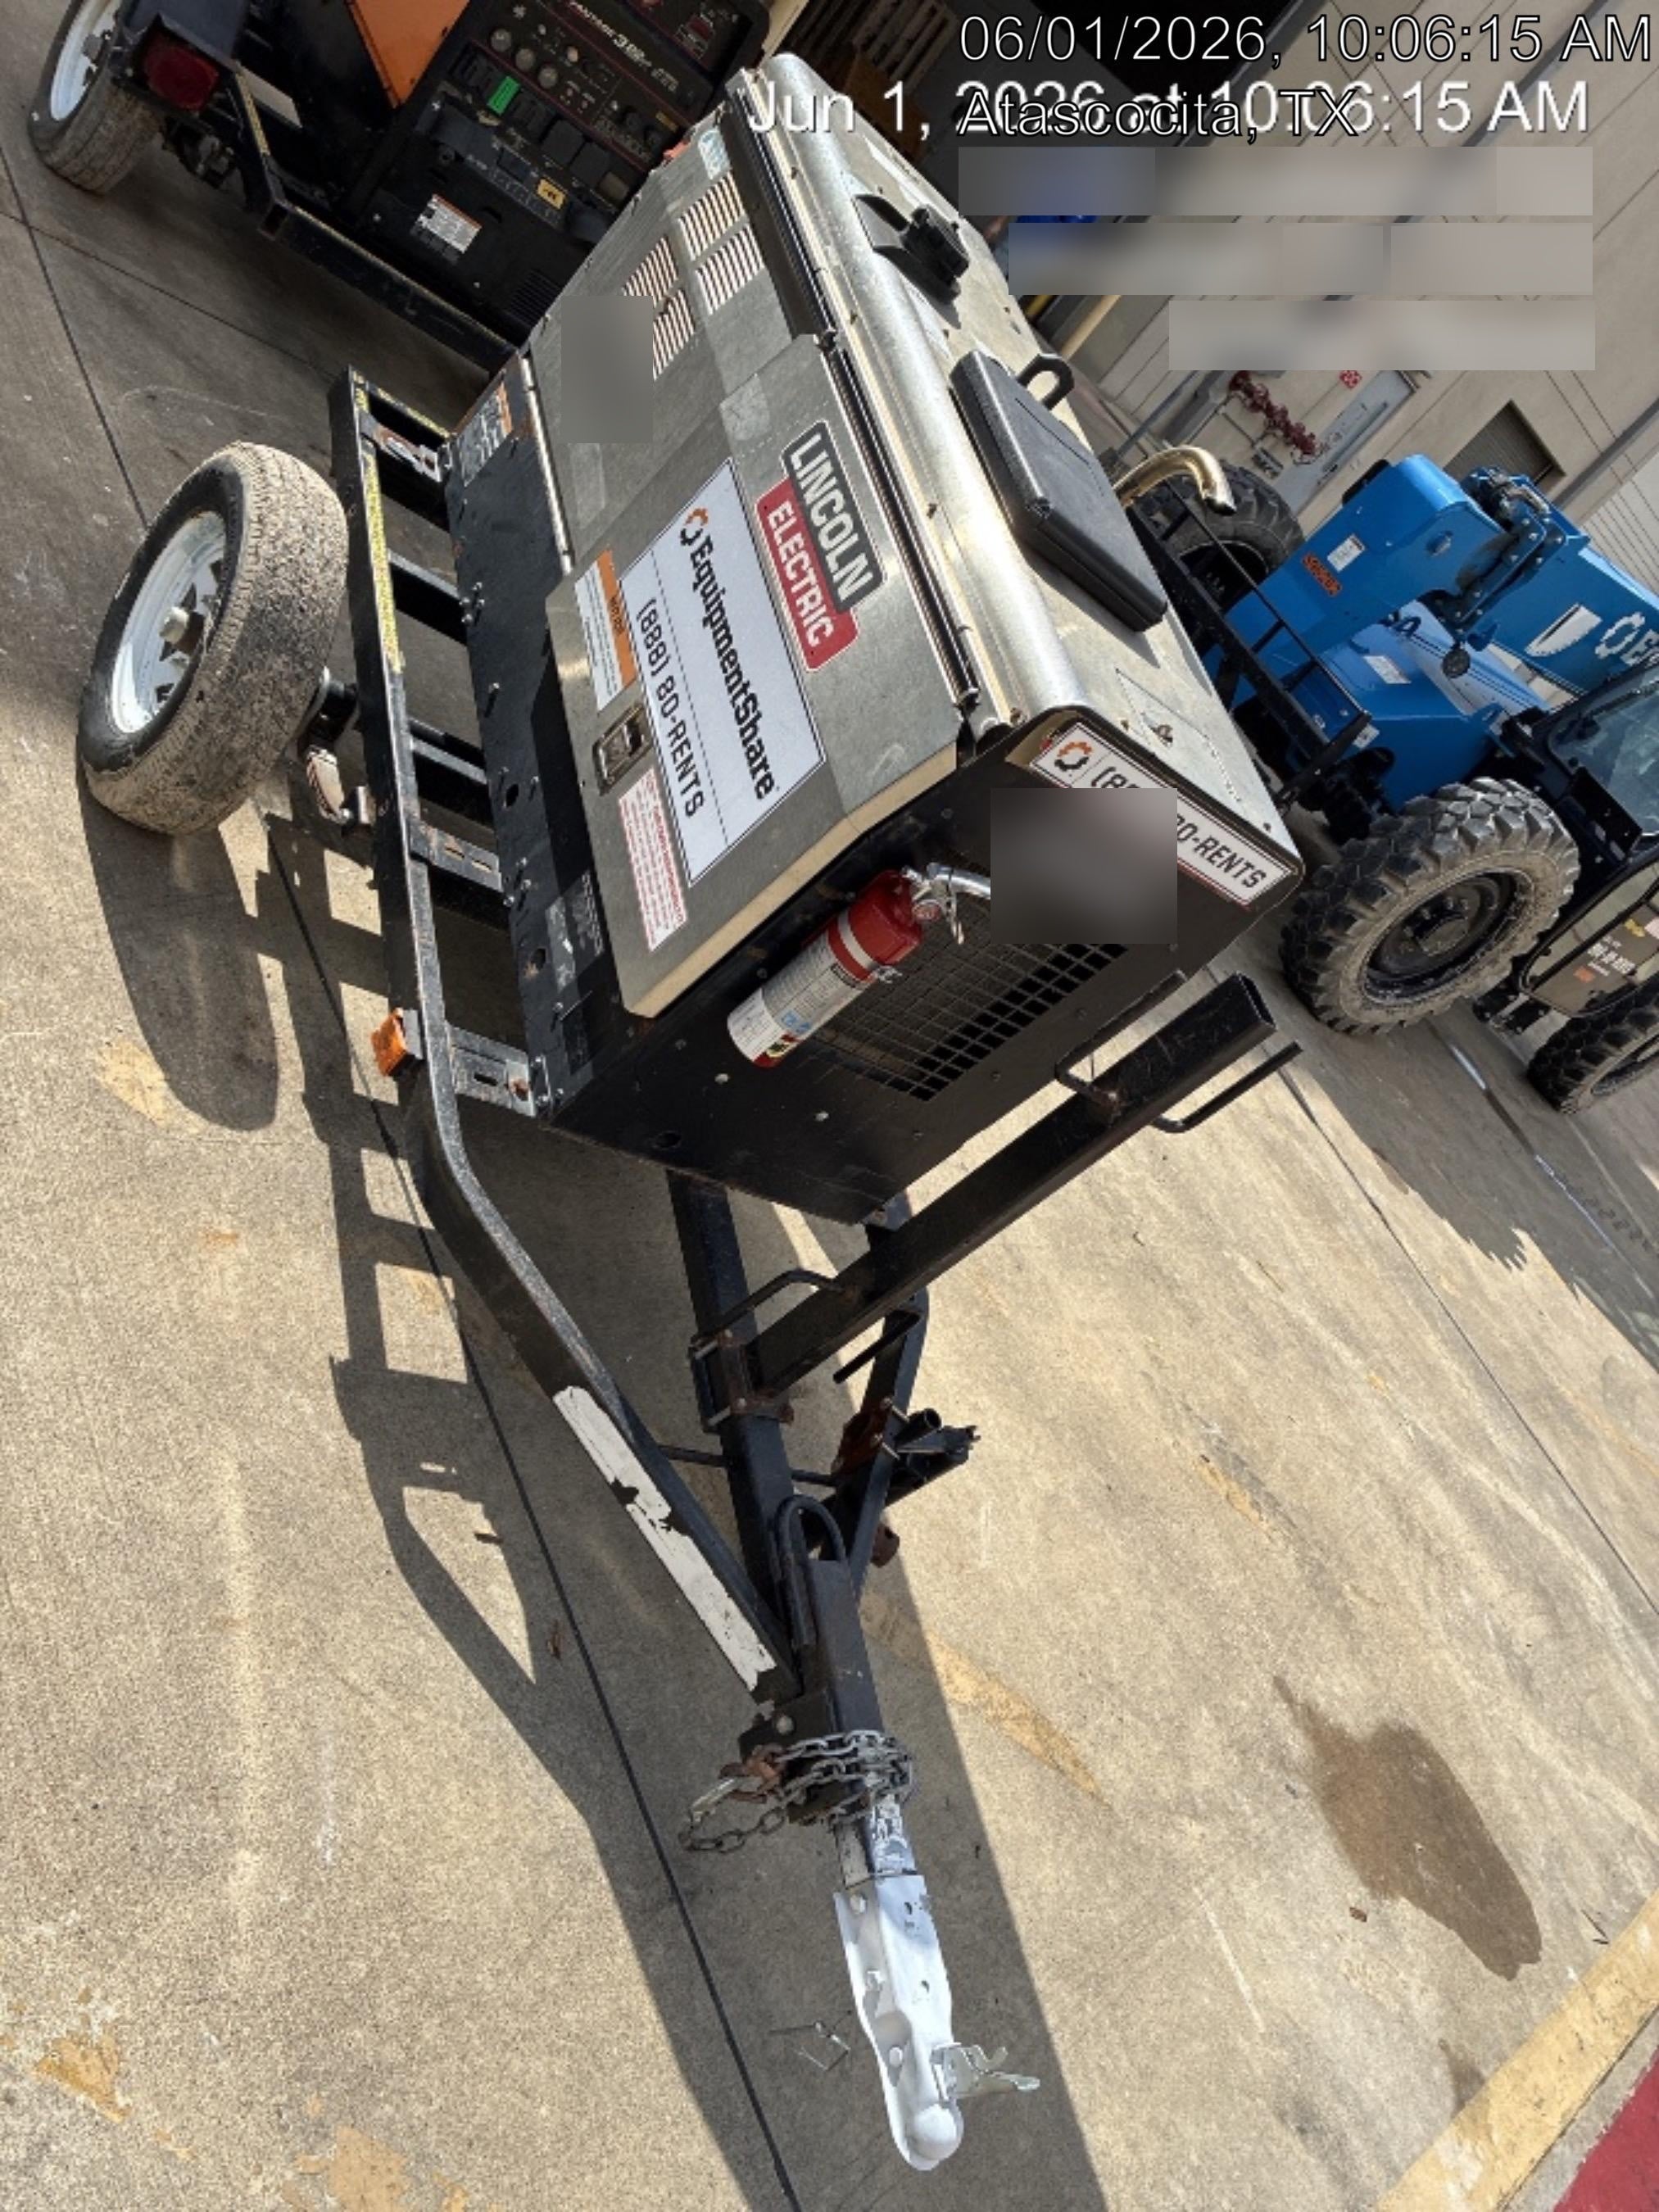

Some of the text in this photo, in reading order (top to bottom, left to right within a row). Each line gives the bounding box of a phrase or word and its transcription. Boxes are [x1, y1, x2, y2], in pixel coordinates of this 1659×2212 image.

[768, 500, 835, 647] ELECTRIC
[790, 433, 873, 601] LINCOLN
[636, 599, 705, 818] (888) 80-RENTS
[690, 534, 777, 800] EquipmentShare
